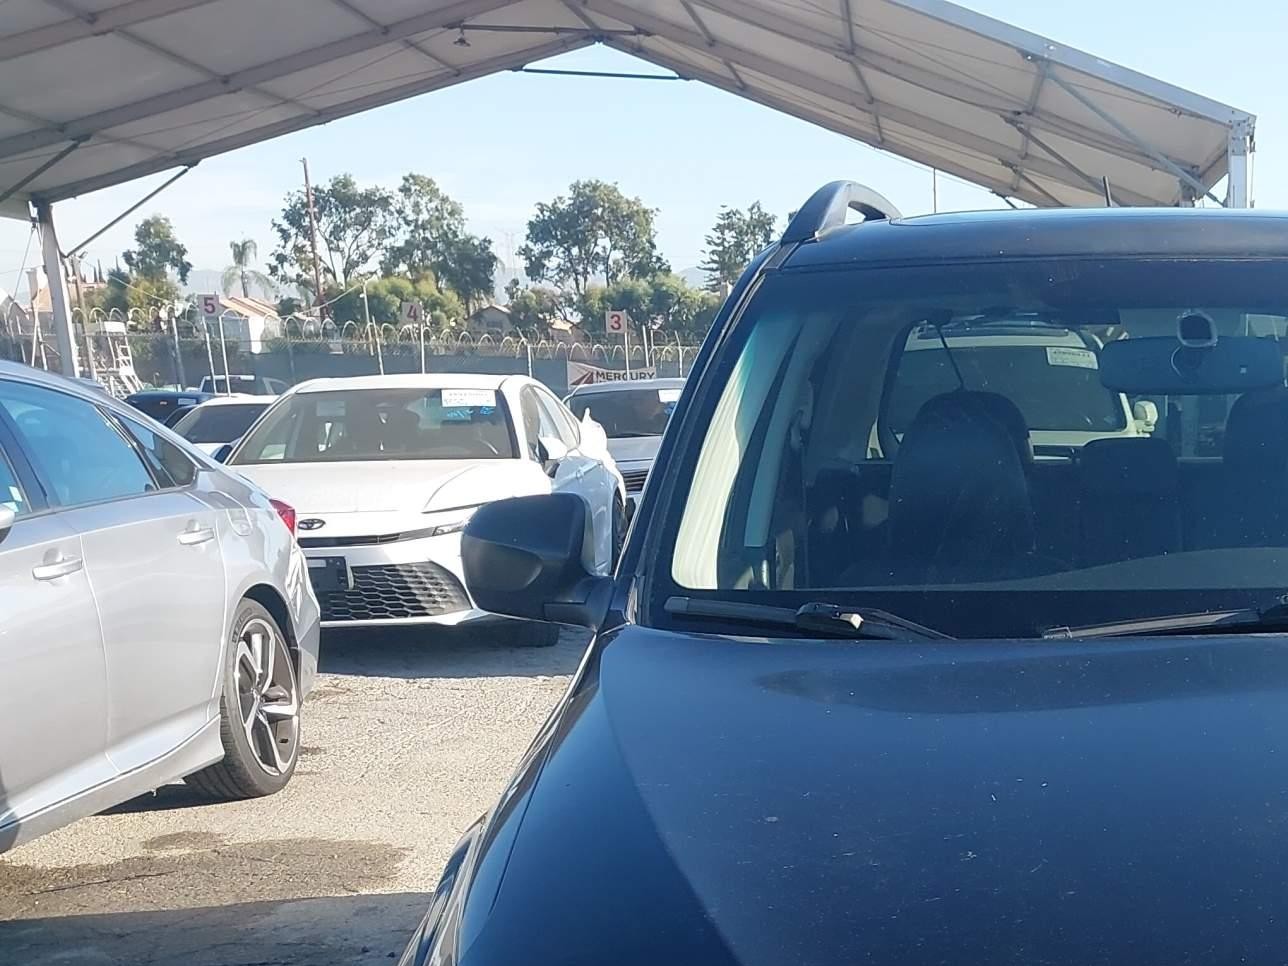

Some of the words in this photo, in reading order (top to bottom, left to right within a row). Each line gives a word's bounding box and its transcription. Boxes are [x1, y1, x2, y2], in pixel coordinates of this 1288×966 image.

[203, 297, 216, 314] 5
[406, 304, 418, 322] 4
[610, 314, 622, 330] 3
[596, 371, 655, 381] MERCURY
